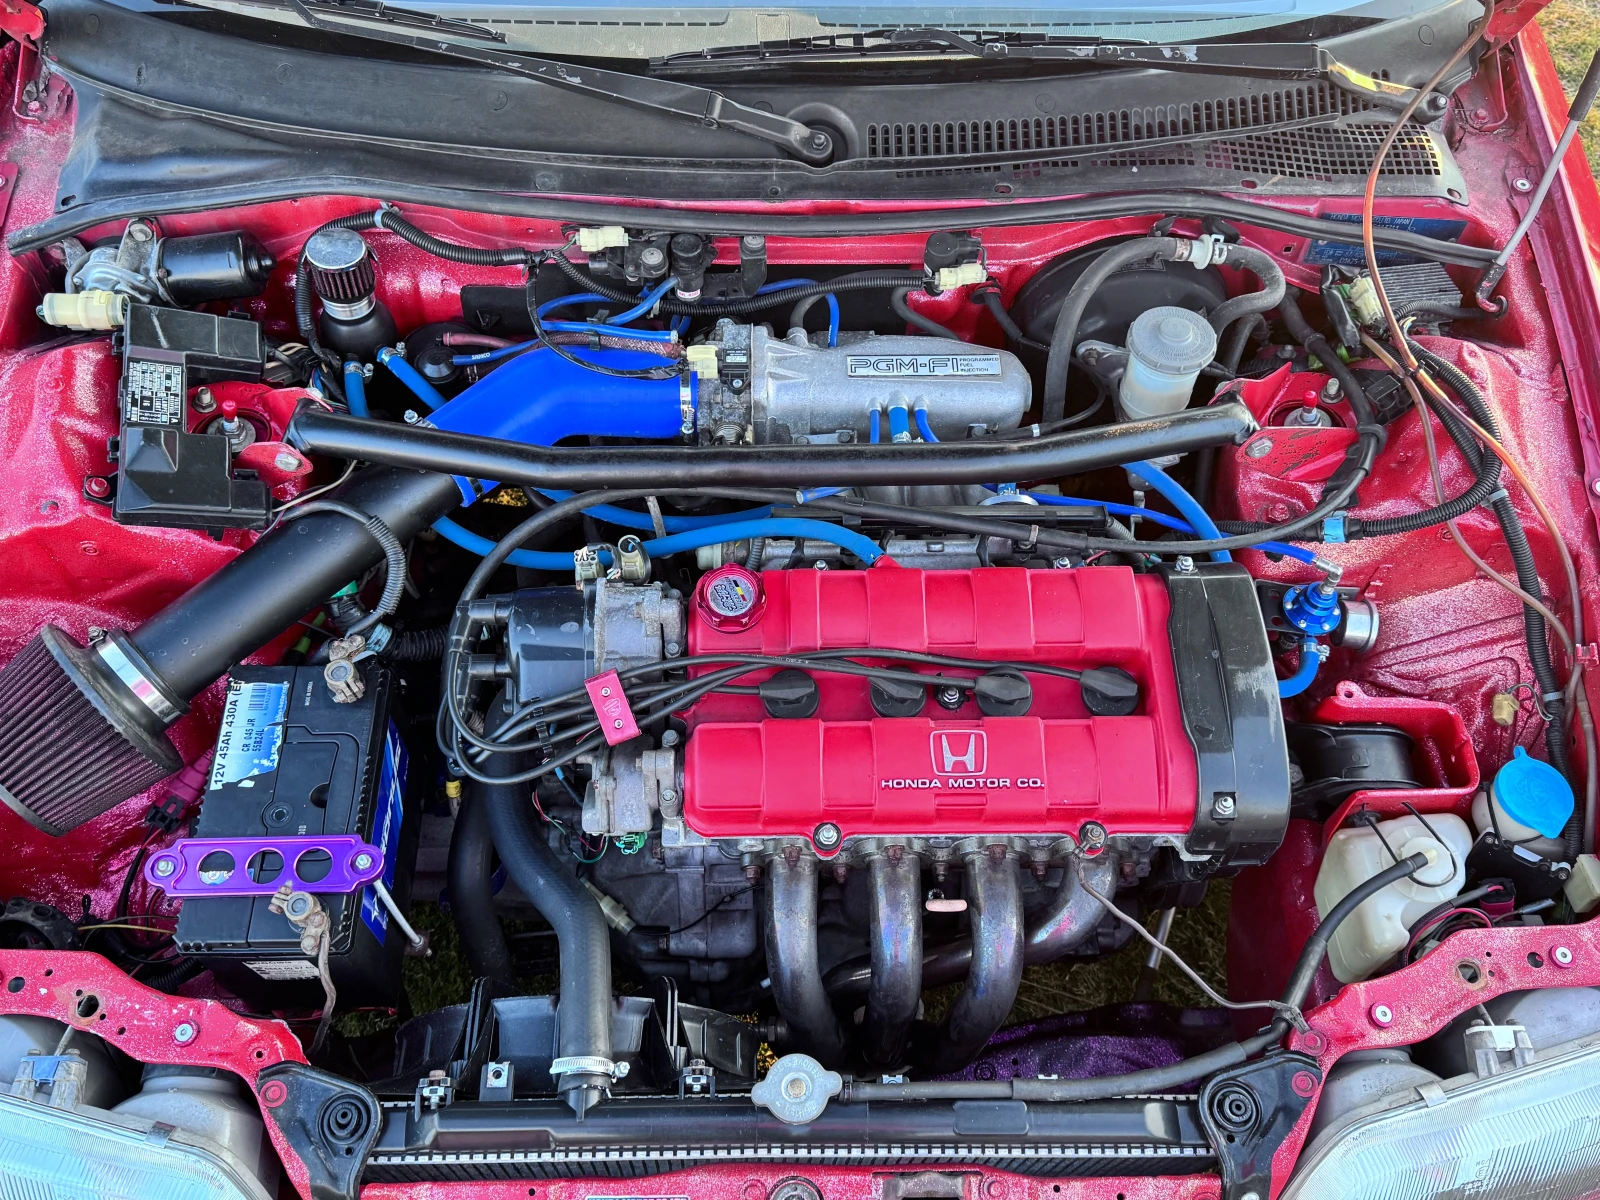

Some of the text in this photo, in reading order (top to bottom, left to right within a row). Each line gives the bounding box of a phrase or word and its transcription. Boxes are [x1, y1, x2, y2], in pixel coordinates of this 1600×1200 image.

[225, 699, 239, 727] 430A
[219, 731, 232, 760] 45Ah
[242, 743, 251, 752] CR
[247, 718, 256, 727] JR
[252, 728, 265, 752] 55B24L
[214, 762, 226, 785] 12V
[881, 778, 1045, 788] HONDA MOTOR CO.
